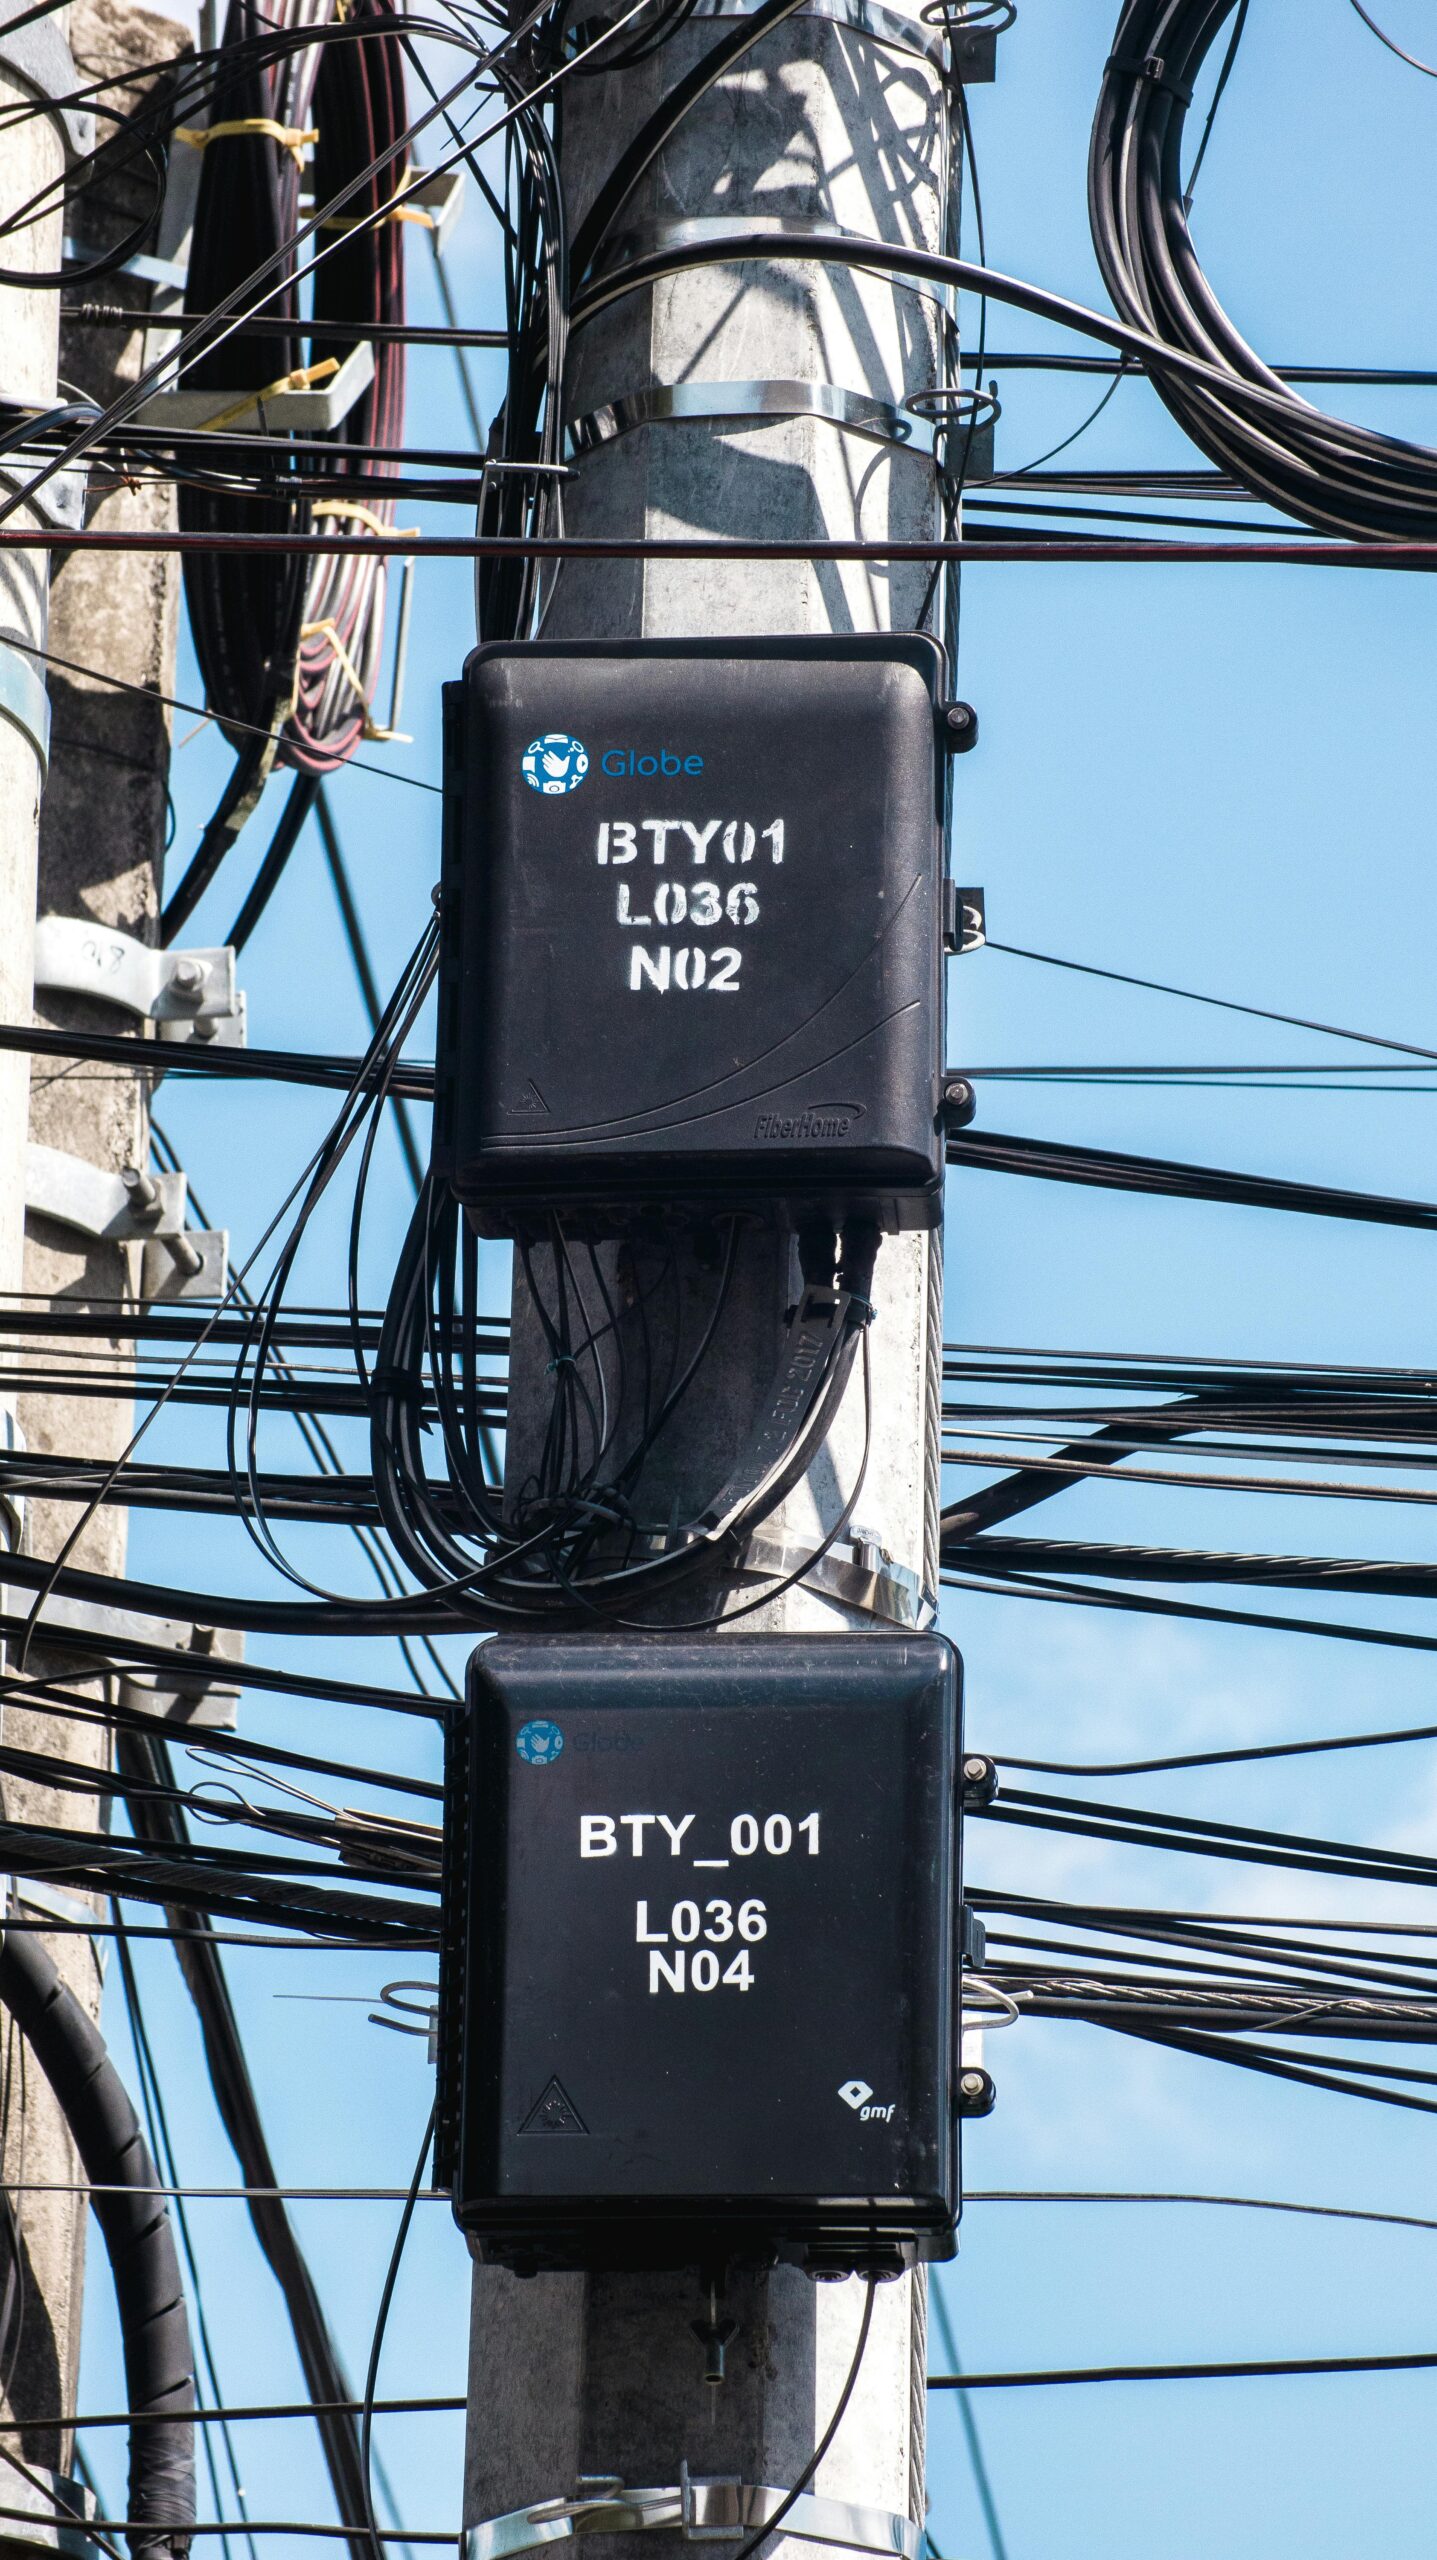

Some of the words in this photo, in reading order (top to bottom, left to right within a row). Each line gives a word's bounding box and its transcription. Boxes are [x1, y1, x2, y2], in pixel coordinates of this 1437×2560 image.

[601, 748, 704, 778] Globe
[596, 819, 785, 866] BTY01
[616, 880, 760, 926] L036
[628, 945, 743, 995] N02
[753, 1111, 851, 1140] FiberHome
[580, 1812, 820, 1868] BTY_001
[636, 1899, 768, 1943] L036
[650, 1949, 755, 1994] N04
[860, 2103, 896, 2123] gmf
